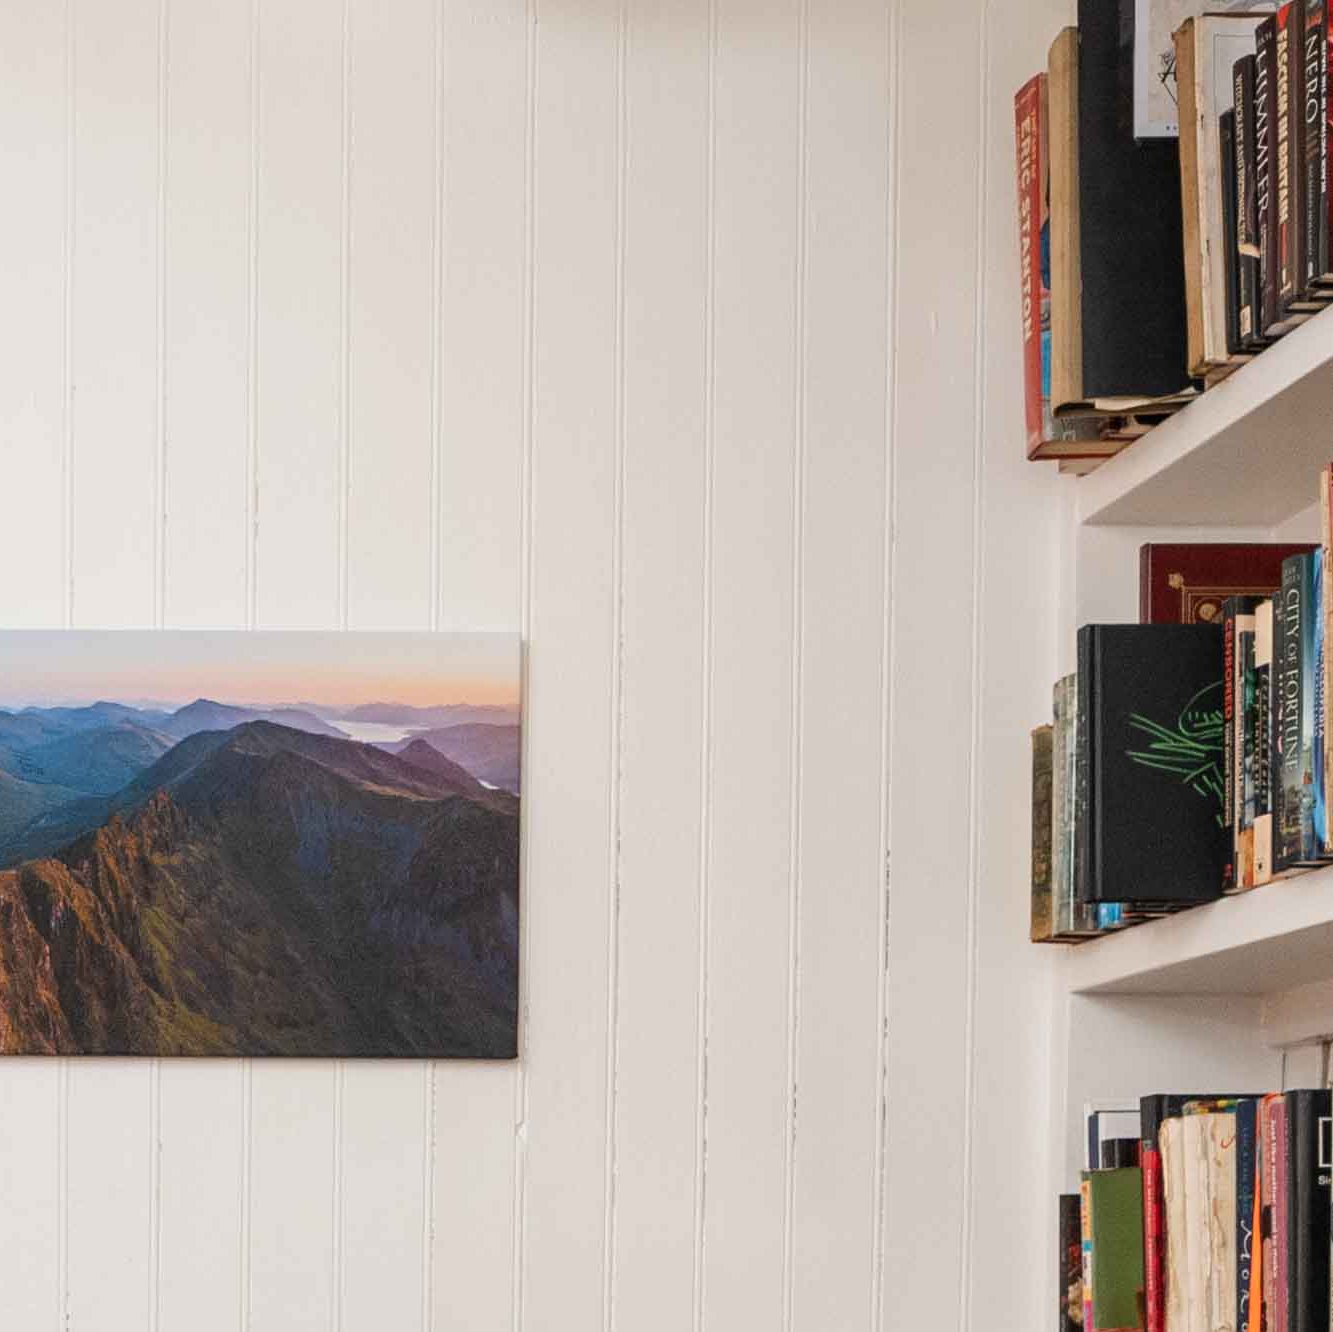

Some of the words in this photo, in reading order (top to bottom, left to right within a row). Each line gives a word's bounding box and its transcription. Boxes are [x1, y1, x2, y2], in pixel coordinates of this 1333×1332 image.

[1276, 28, 1288, 114] FASCISM
[1305, 32, 1319, 124] NERO
[1019, 115, 1031, 189] ERIC
[1256, 49, 1270, 217] HIMMLER
[1276, 114, 1287, 137] IN
[1277, 140, 1289, 225] BRITAIN
[1020, 196, 1034, 344] STANTON
[1285, 588, 1301, 637] CITY
[1286, 642, 1298, 665] OF
[1224, 617, 1234, 720] CENSORED
[1285, 669, 1302, 771] FORTUNE
